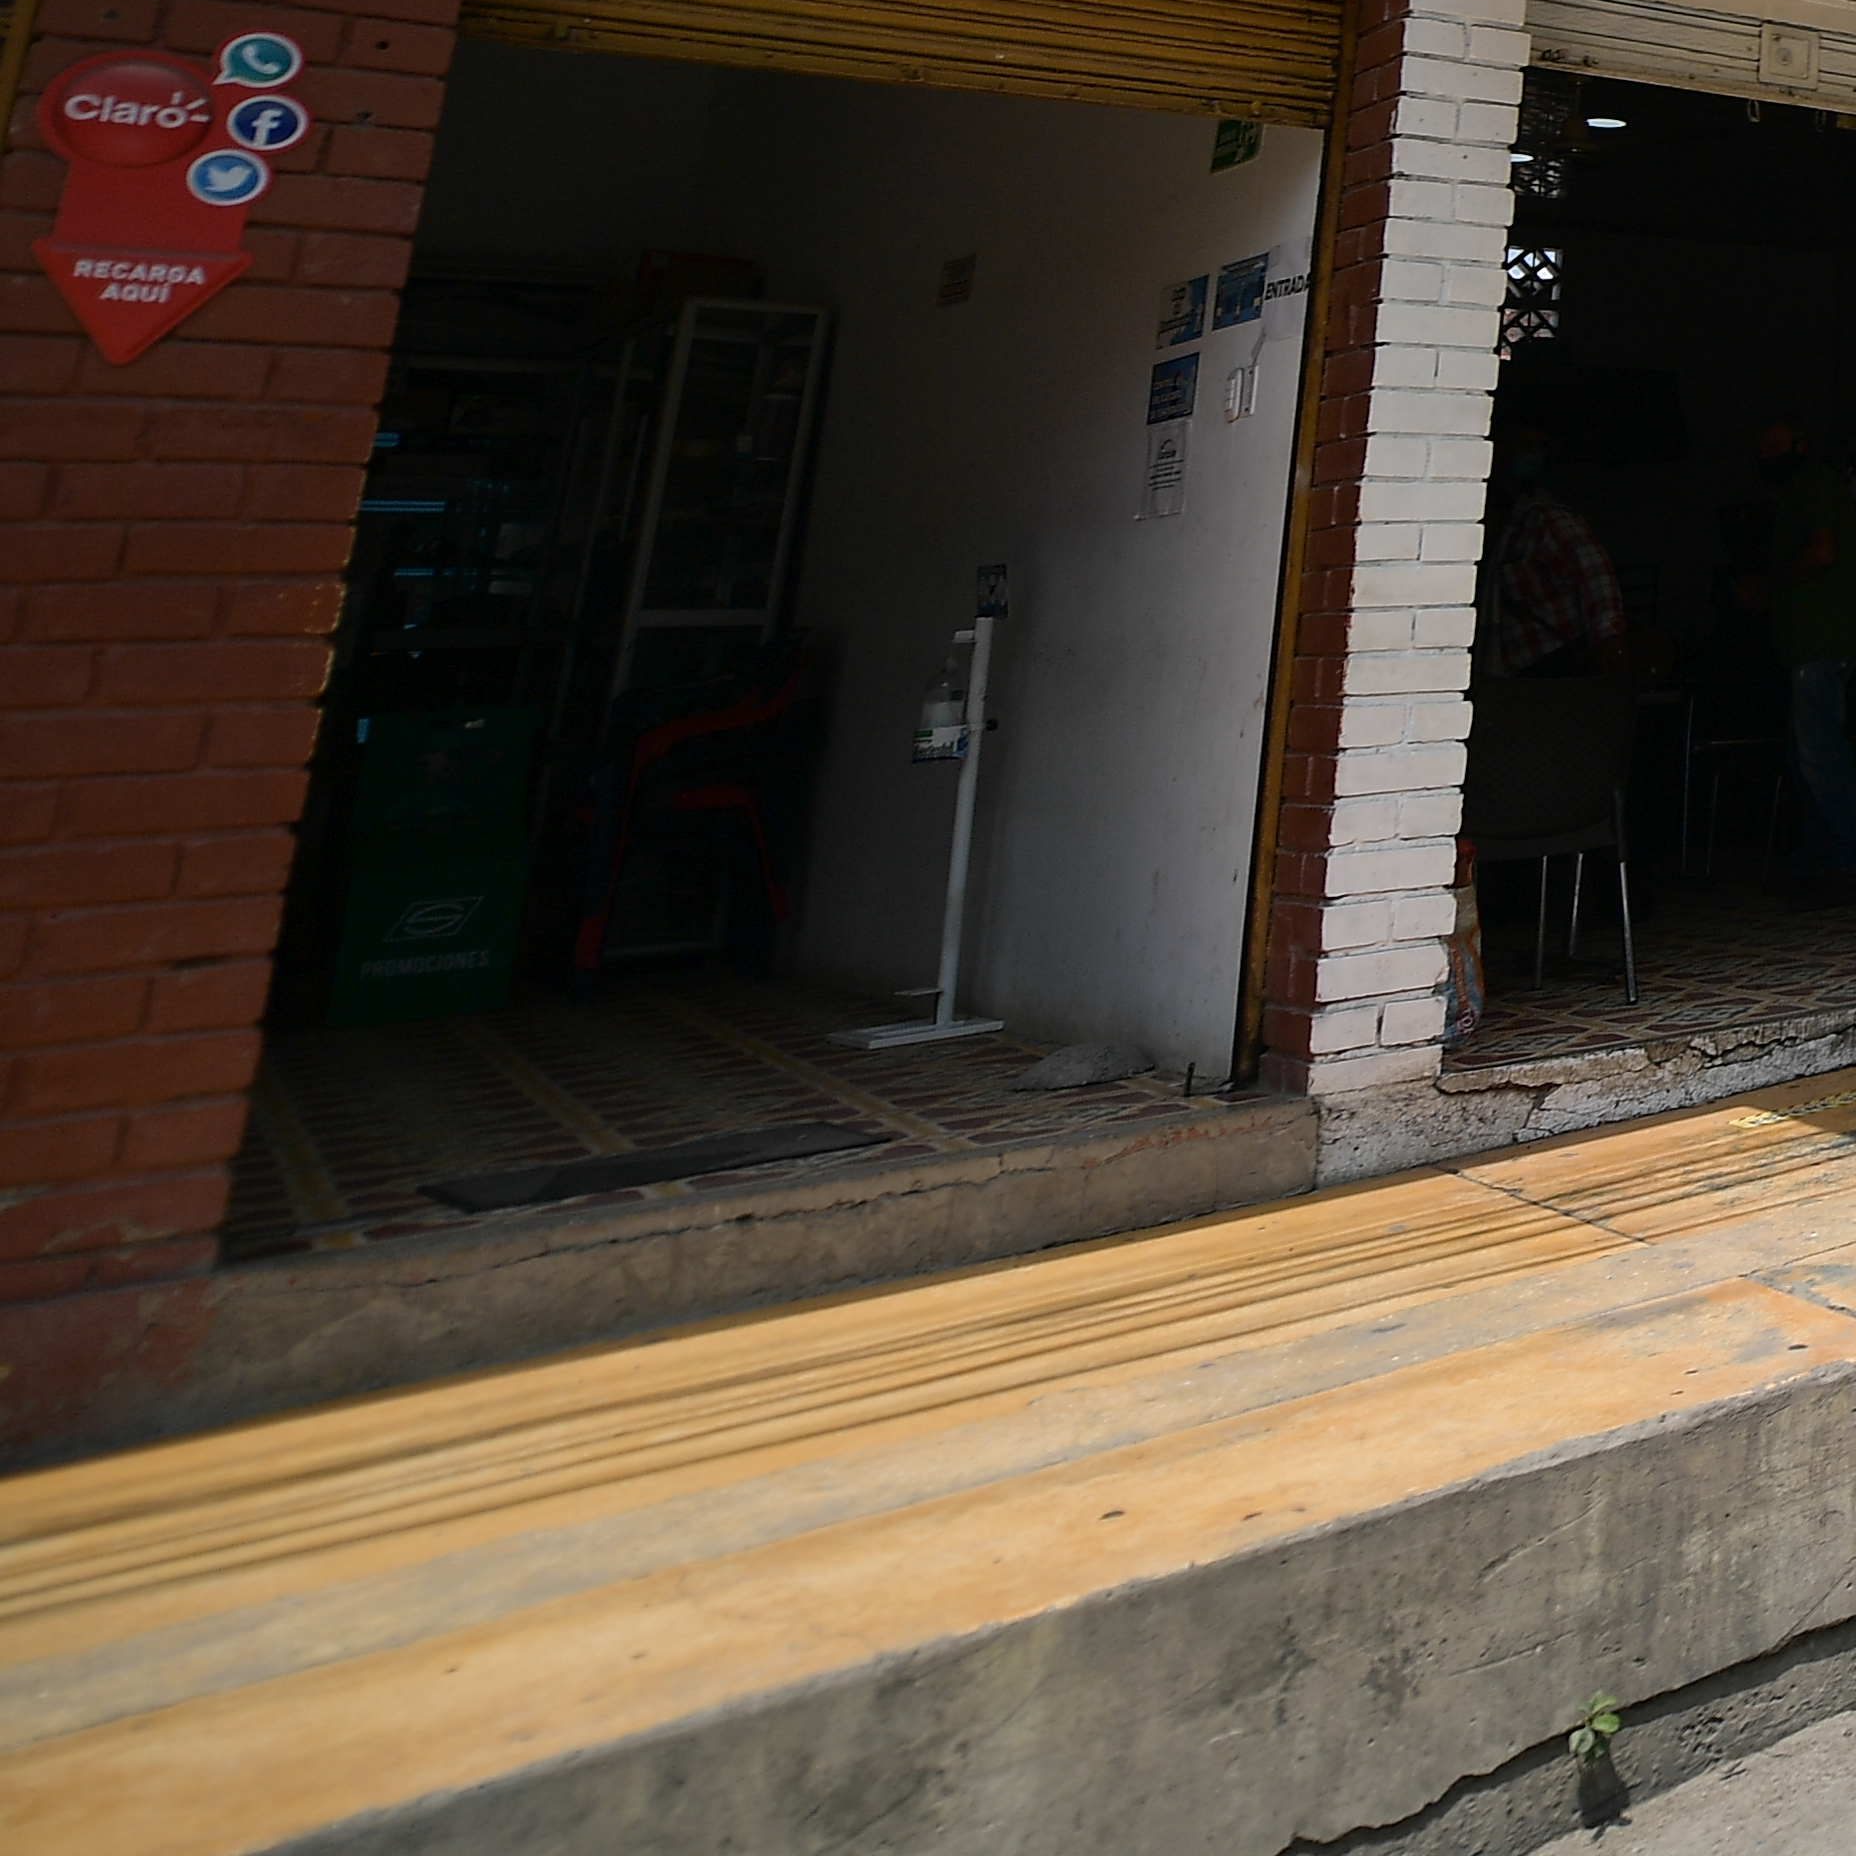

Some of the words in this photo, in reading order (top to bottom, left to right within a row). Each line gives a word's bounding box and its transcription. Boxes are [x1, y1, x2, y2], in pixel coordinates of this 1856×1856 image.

[63, 90, 212, 130] Claro
[72, 258, 206, 285] RECARGA
[99, 282, 172, 304] AQUÍ
[358, 950, 491, 979] PROMOCIONES
